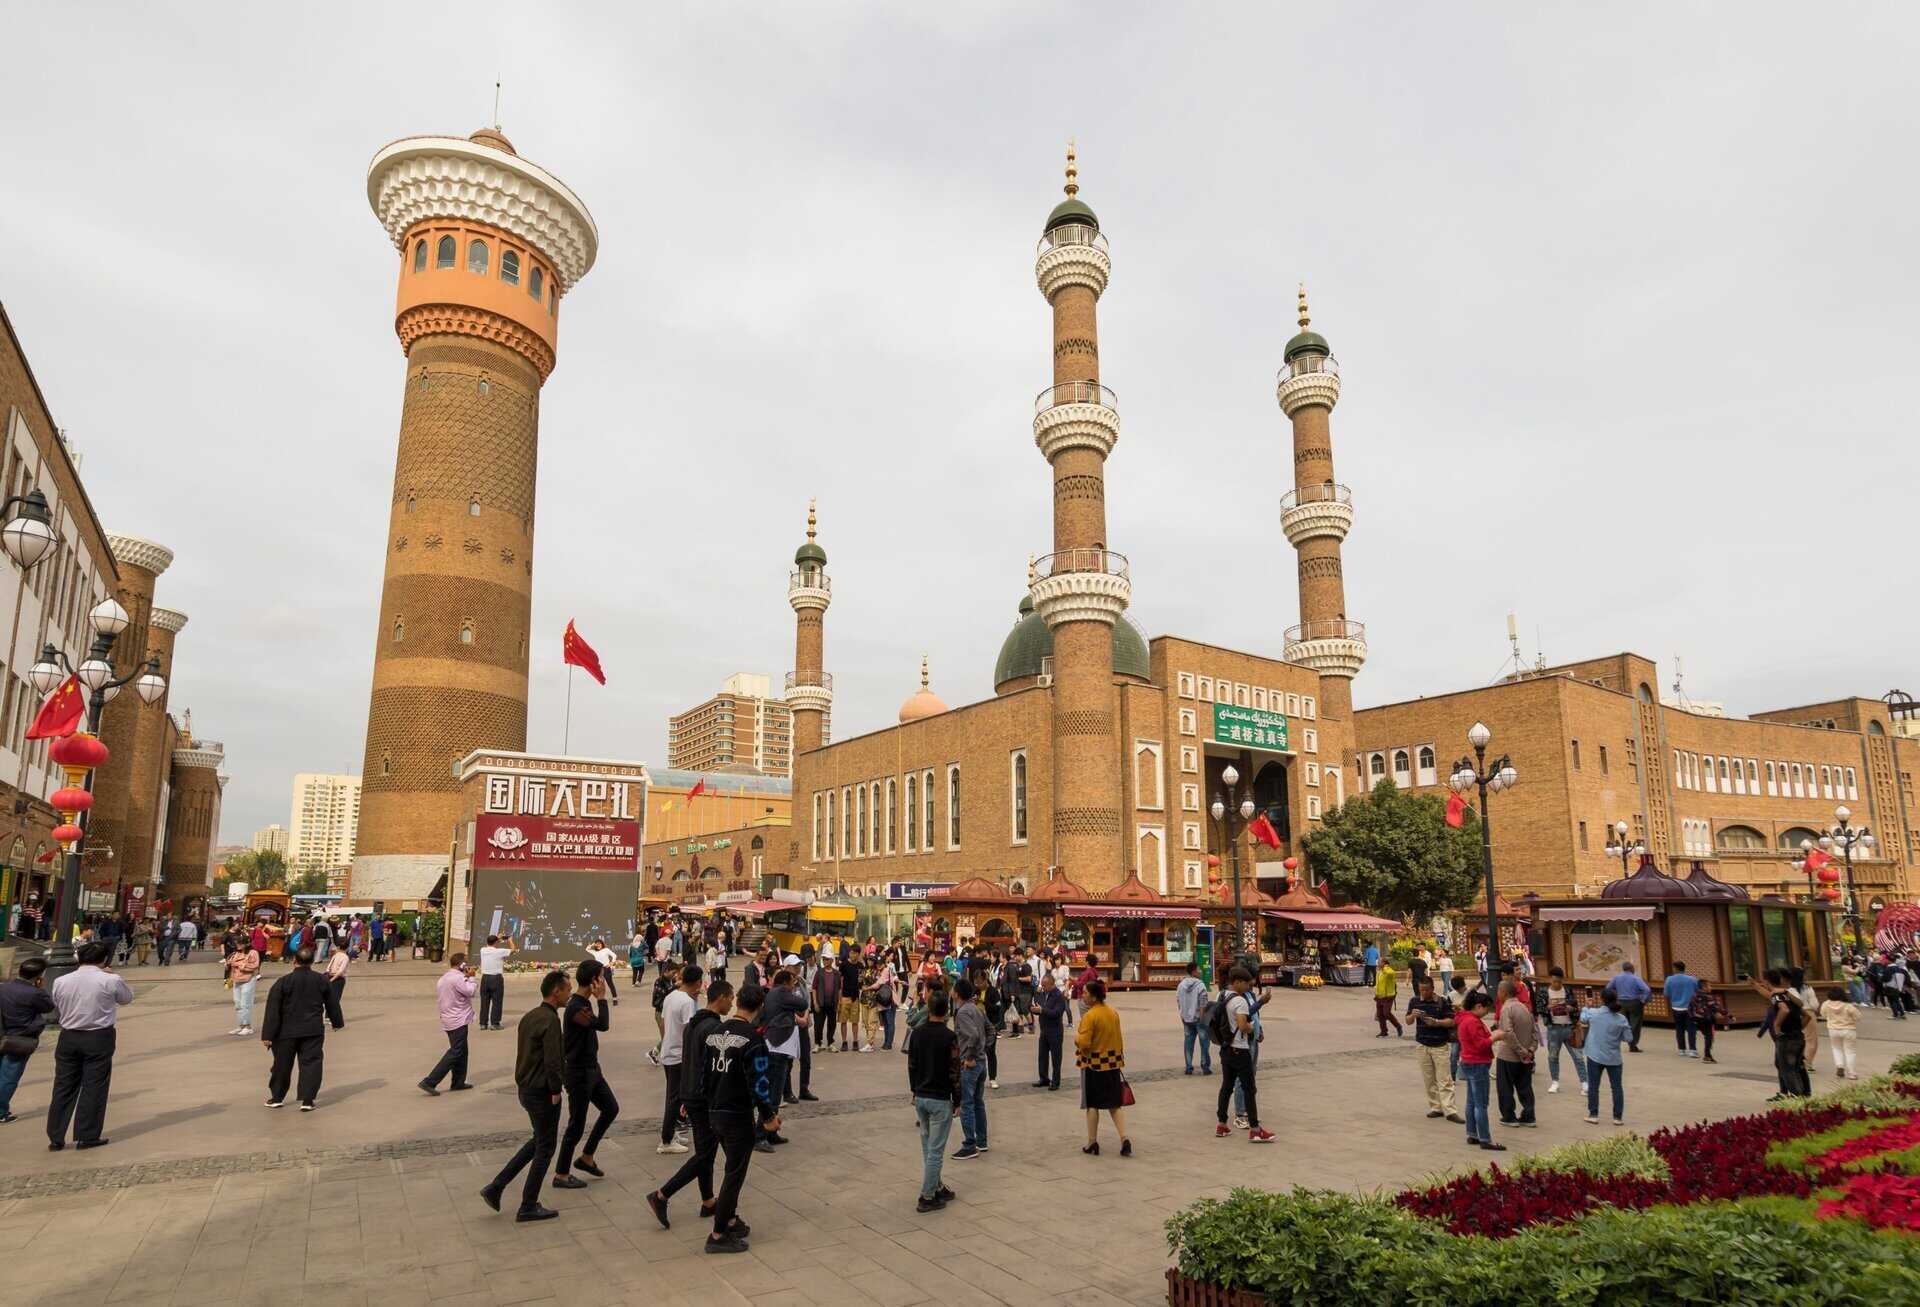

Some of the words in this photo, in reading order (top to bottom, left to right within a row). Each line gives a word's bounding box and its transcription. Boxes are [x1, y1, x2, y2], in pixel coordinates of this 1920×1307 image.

[485, 774, 635, 819] 国际大巴扎
